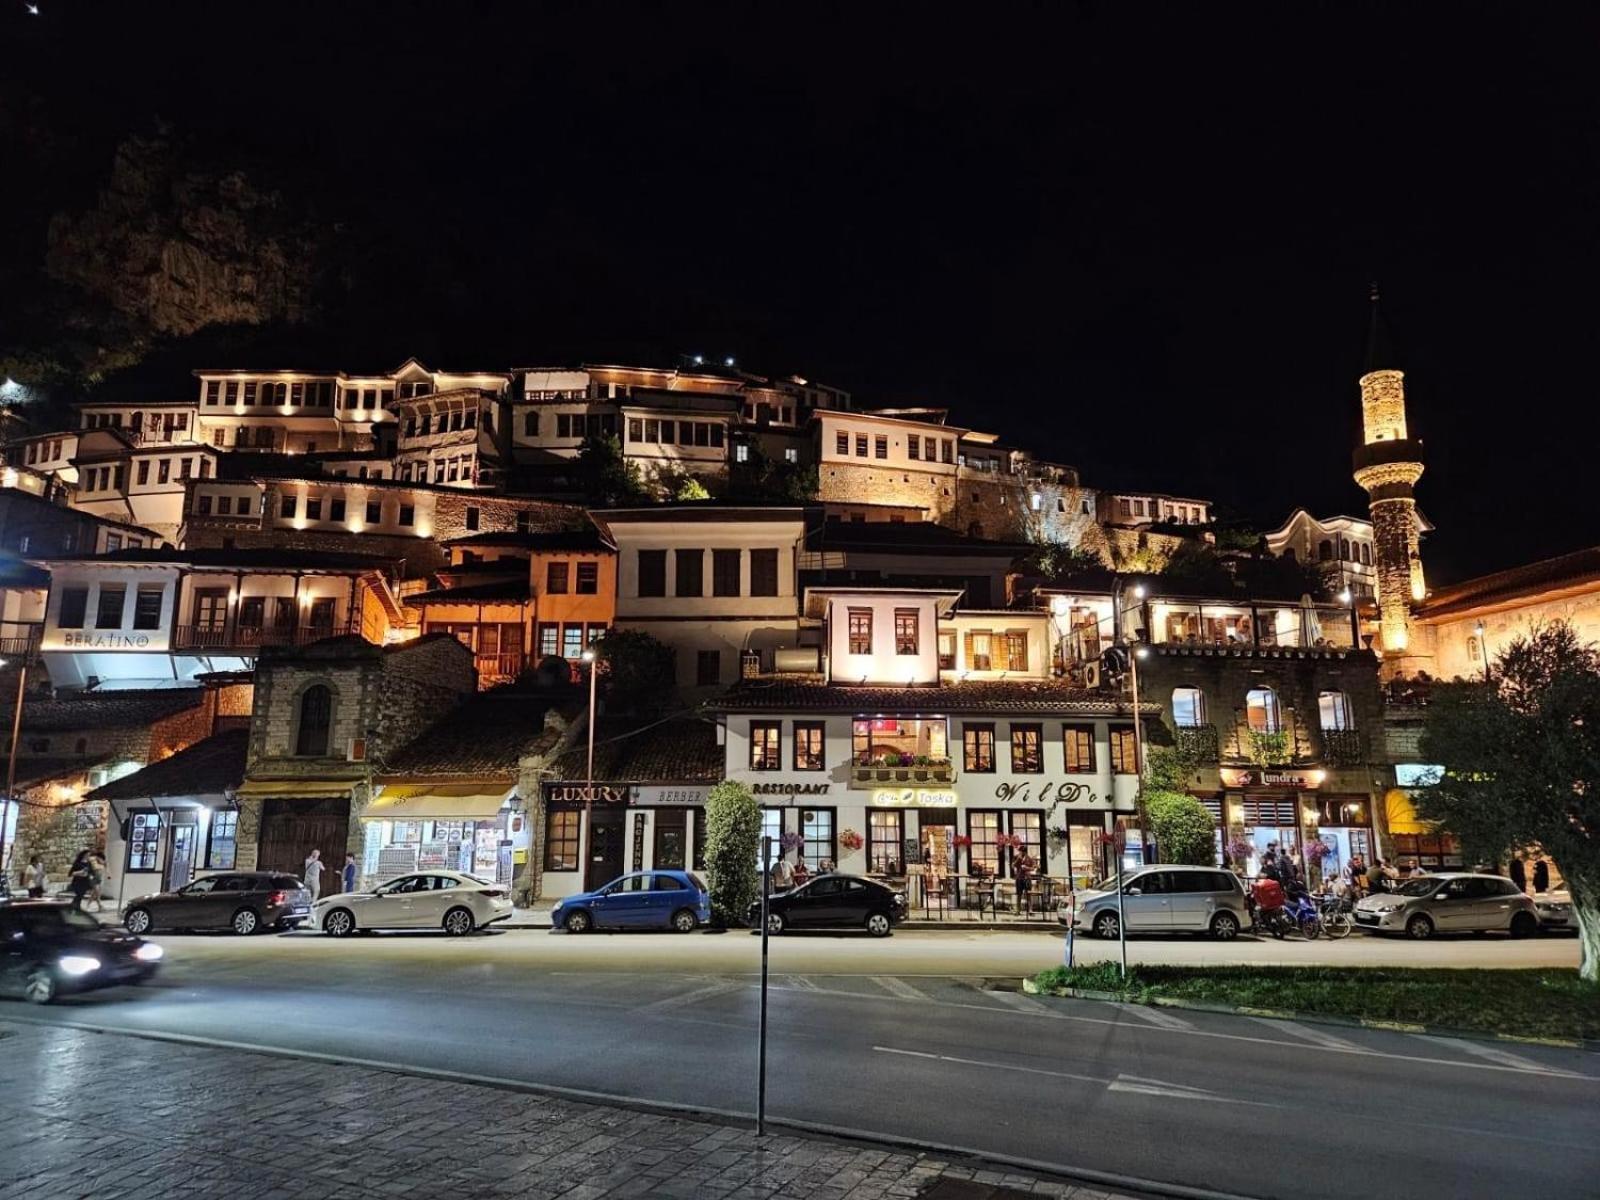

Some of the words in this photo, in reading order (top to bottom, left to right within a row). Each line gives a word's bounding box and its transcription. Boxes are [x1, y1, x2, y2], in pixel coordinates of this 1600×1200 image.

[64, 633, 149, 648] BERATINO
[551, 786, 625, 802] LUXURY
[752, 783, 830, 795] RESTORANT
